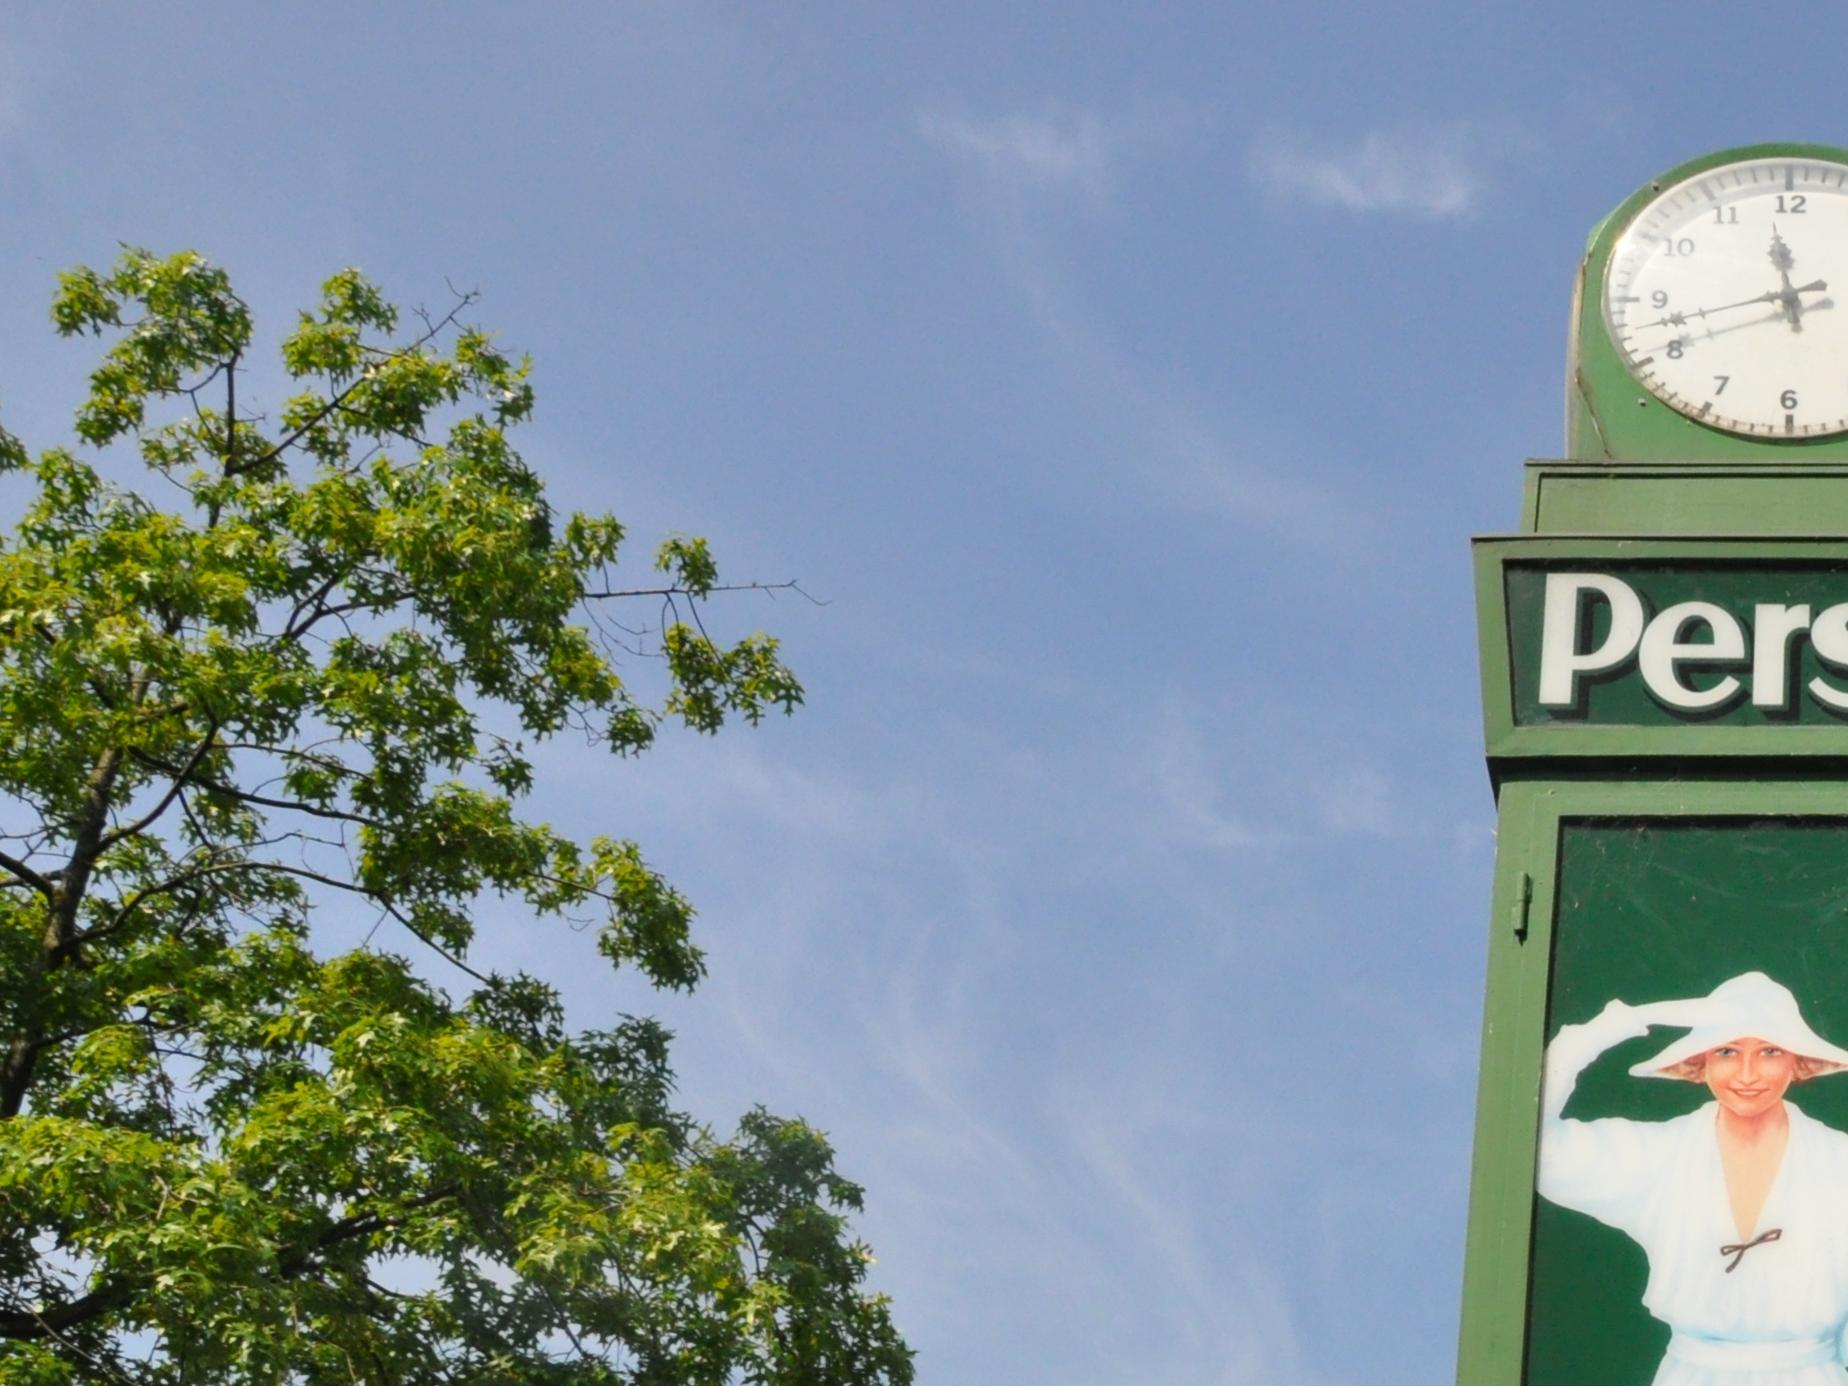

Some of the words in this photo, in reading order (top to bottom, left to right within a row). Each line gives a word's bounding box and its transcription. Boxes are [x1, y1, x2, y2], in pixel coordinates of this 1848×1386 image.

[1775, 195, 1807, 214] 12
[1712, 206, 1740, 225] 11
[1664, 238, 1695, 257] 10
[1651, 290, 1669, 309] 9
[1666, 340, 1684, 360] 8
[1713, 376, 1731, 396] 7
[1780, 389, 1798, 409] 6
